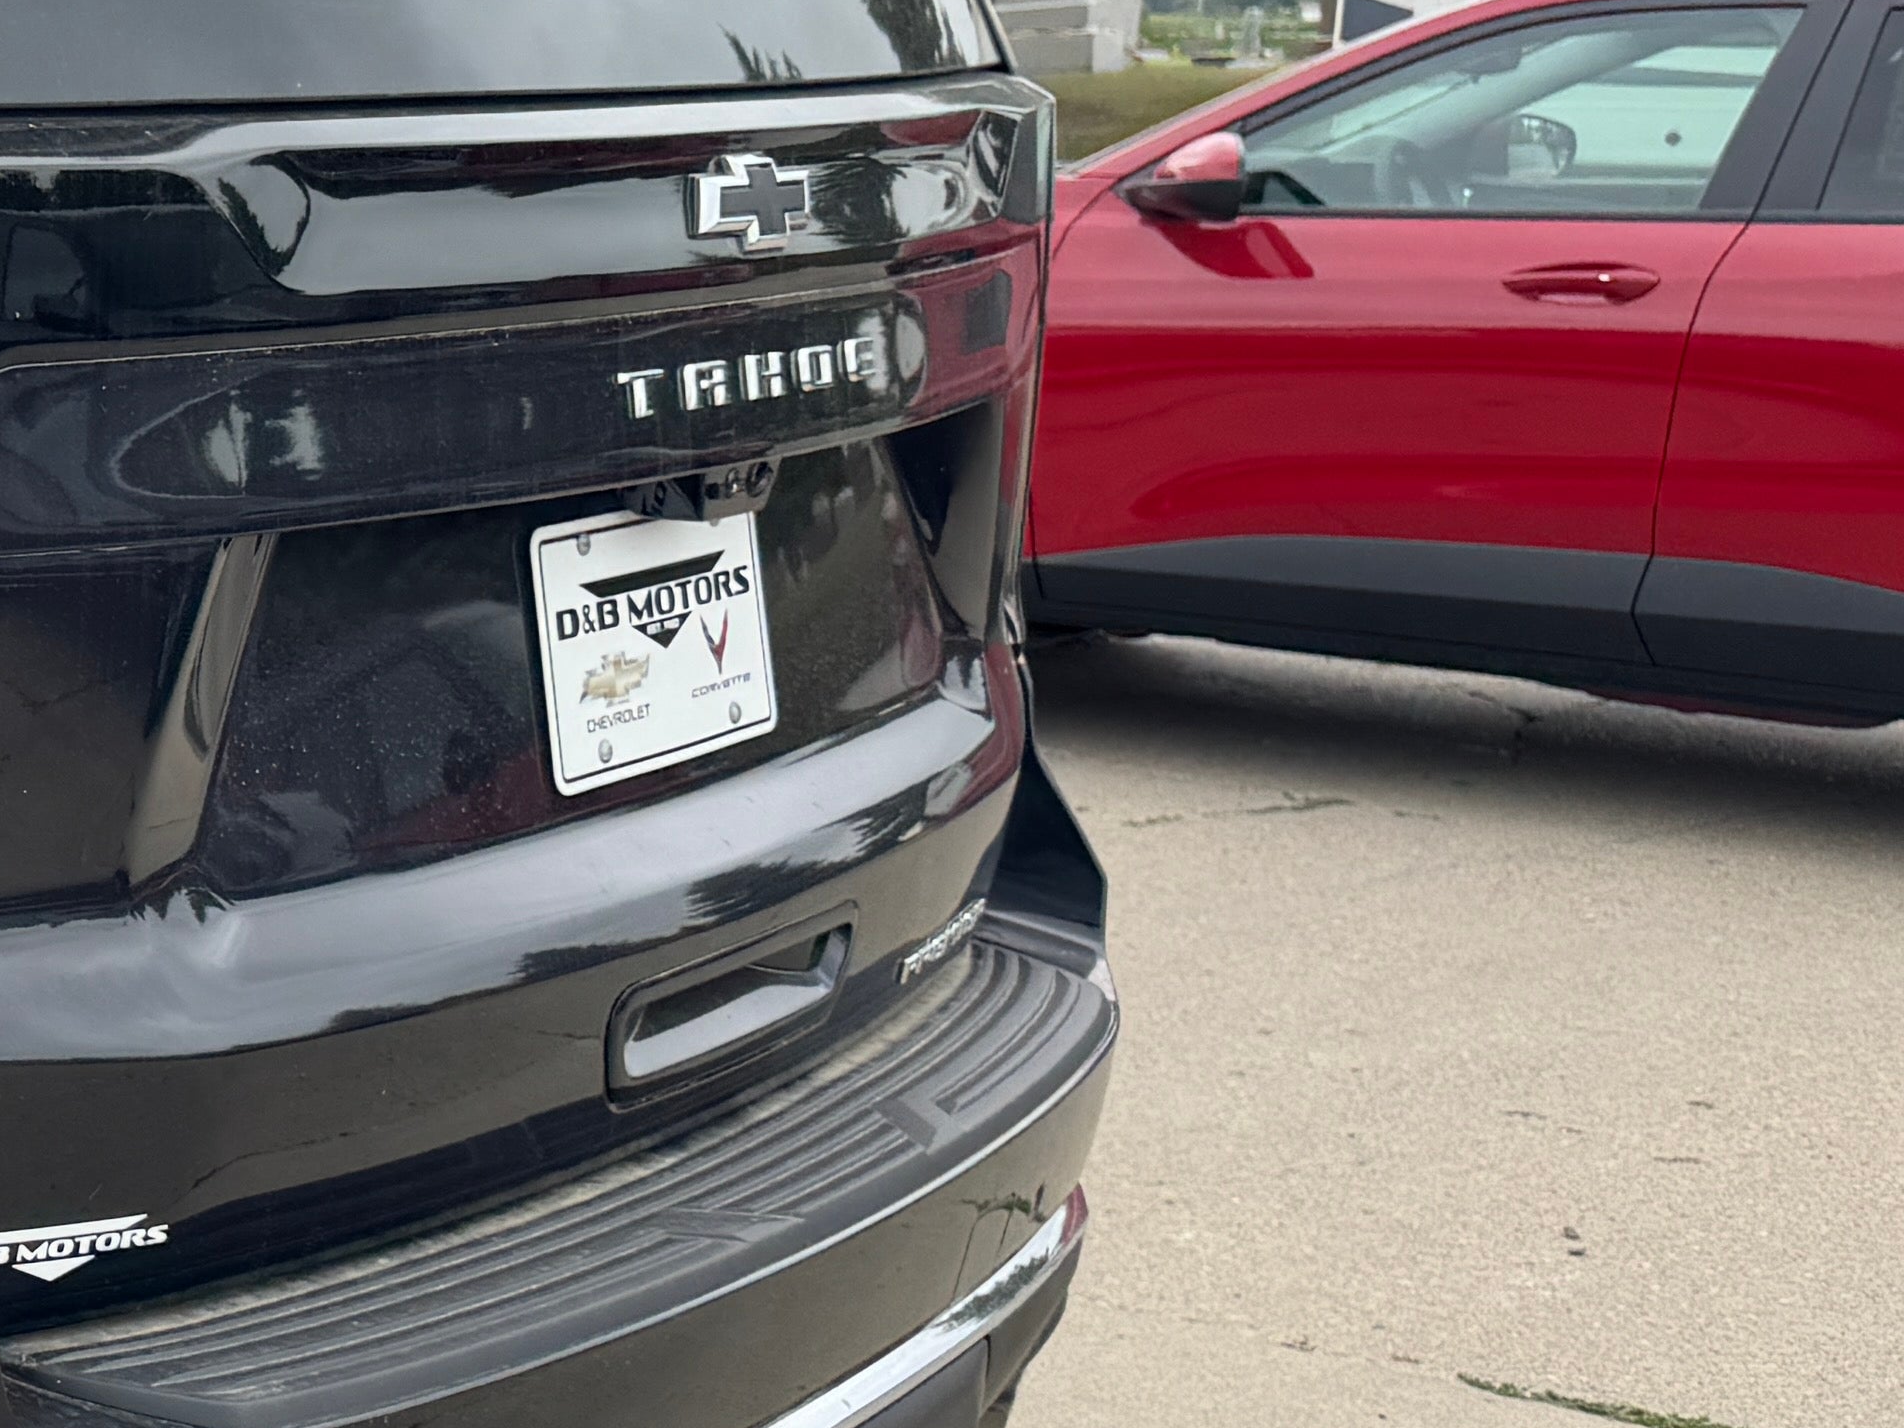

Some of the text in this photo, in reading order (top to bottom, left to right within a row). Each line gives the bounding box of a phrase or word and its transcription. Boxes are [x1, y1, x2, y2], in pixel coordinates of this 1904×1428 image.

[612, 336, 876, 420] TAHOE
[555, 565, 750, 641] D&B MOTORS
[586, 703, 651, 734] CHEVROLET
[16, 1224, 169, 1263] MOTORS
